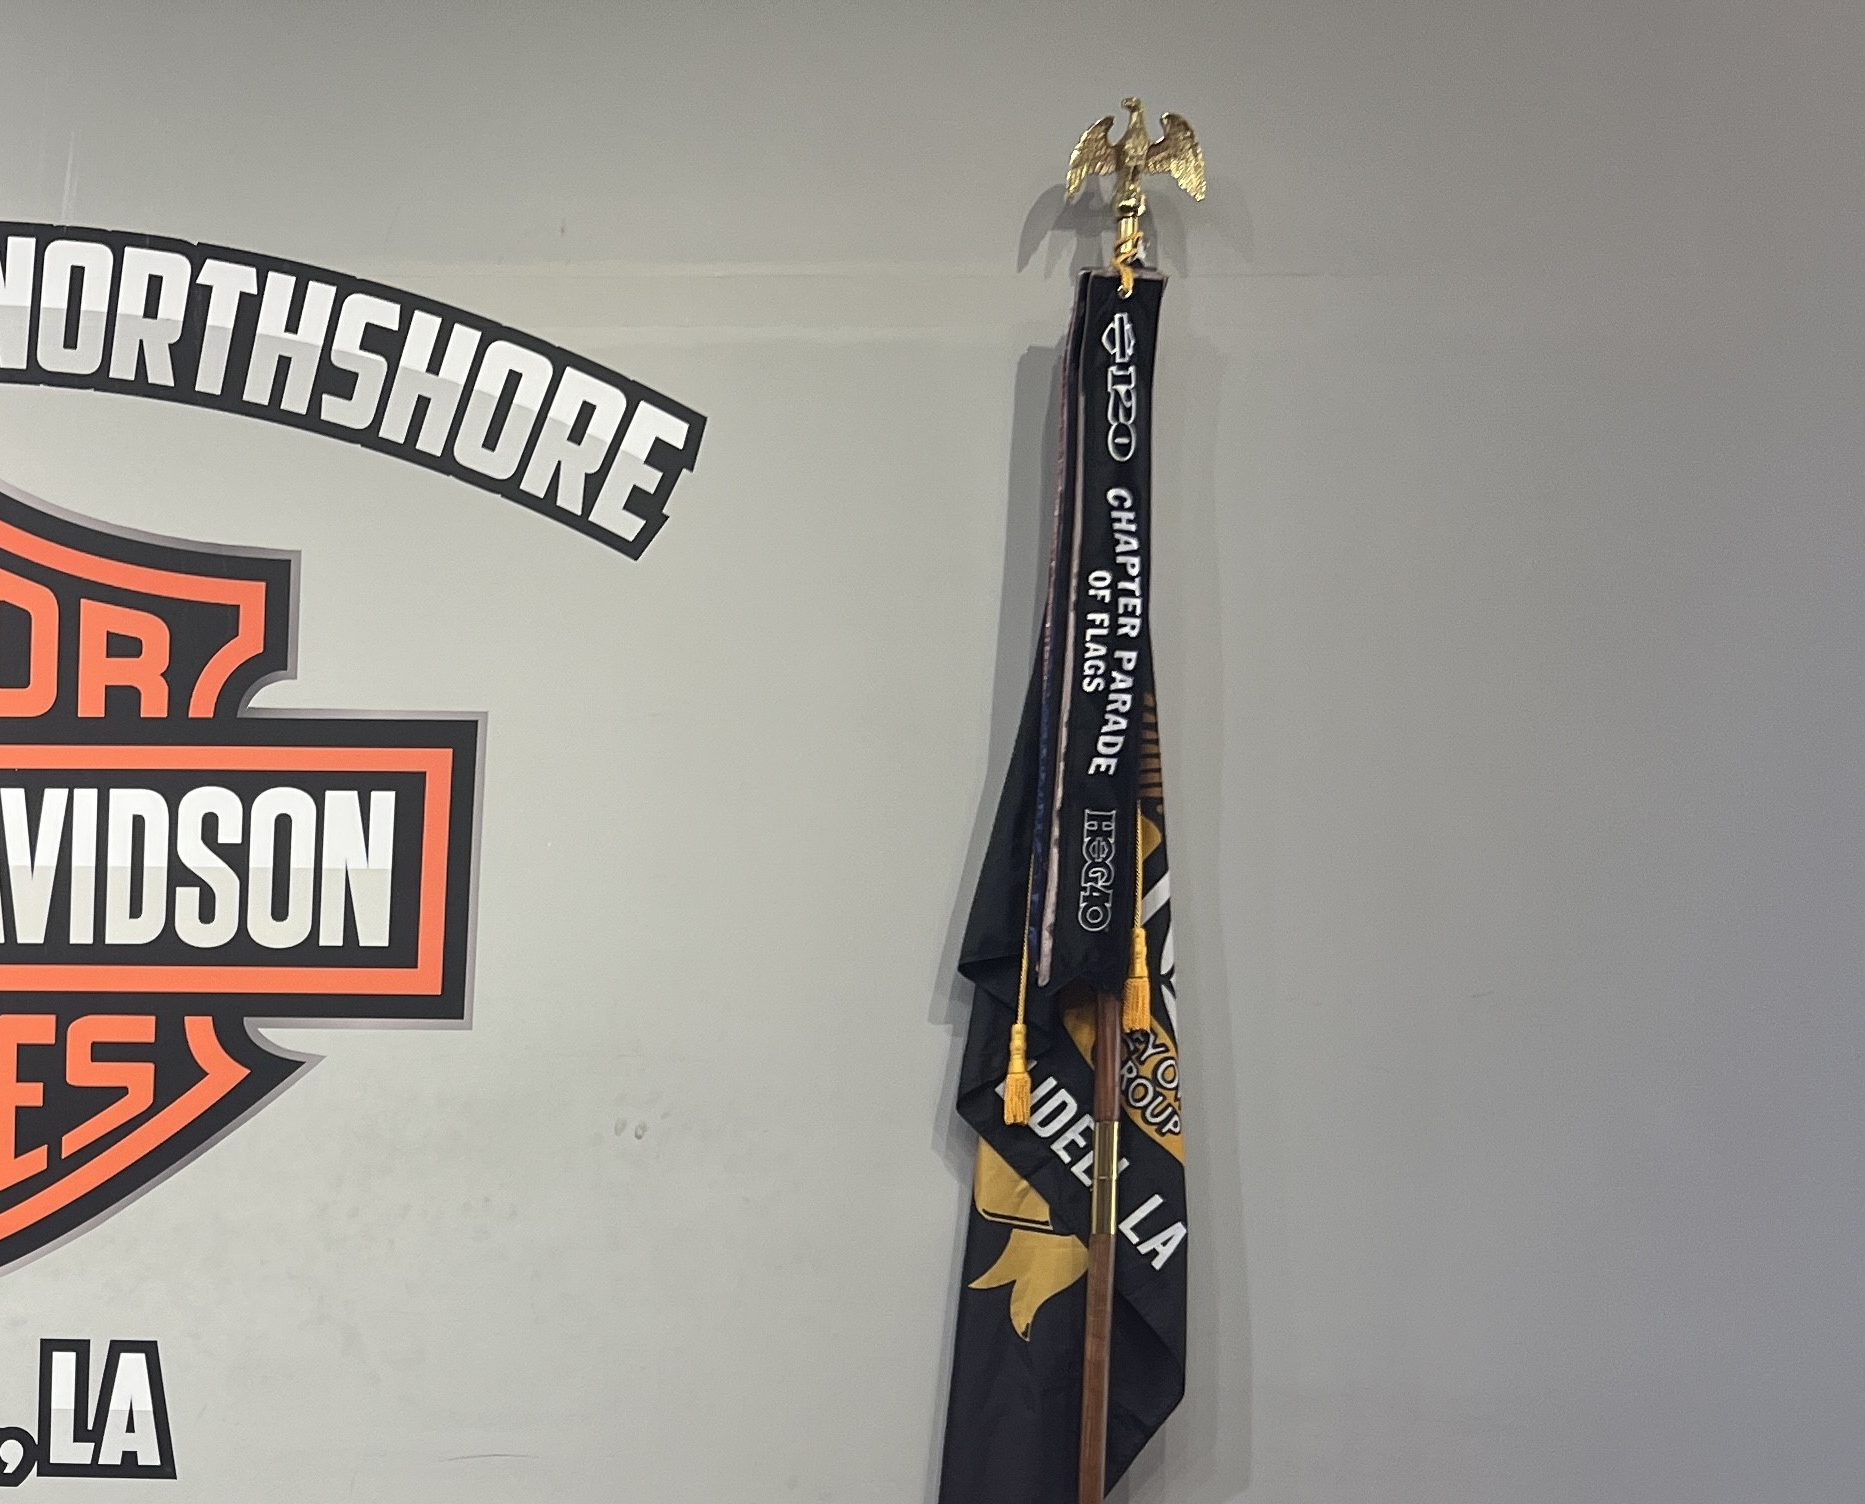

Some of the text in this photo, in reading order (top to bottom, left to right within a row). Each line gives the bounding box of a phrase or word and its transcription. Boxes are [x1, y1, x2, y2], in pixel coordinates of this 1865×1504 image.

[1082, 569, 1113, 694] OF FLAGS
[1087, 487, 1142, 777] CHAPTER PARADE
[1120, 1060, 1181, 1133] ROUP
[1117, 1193, 1187, 1271] LA
[49, 1350, 162, 1467] LA
